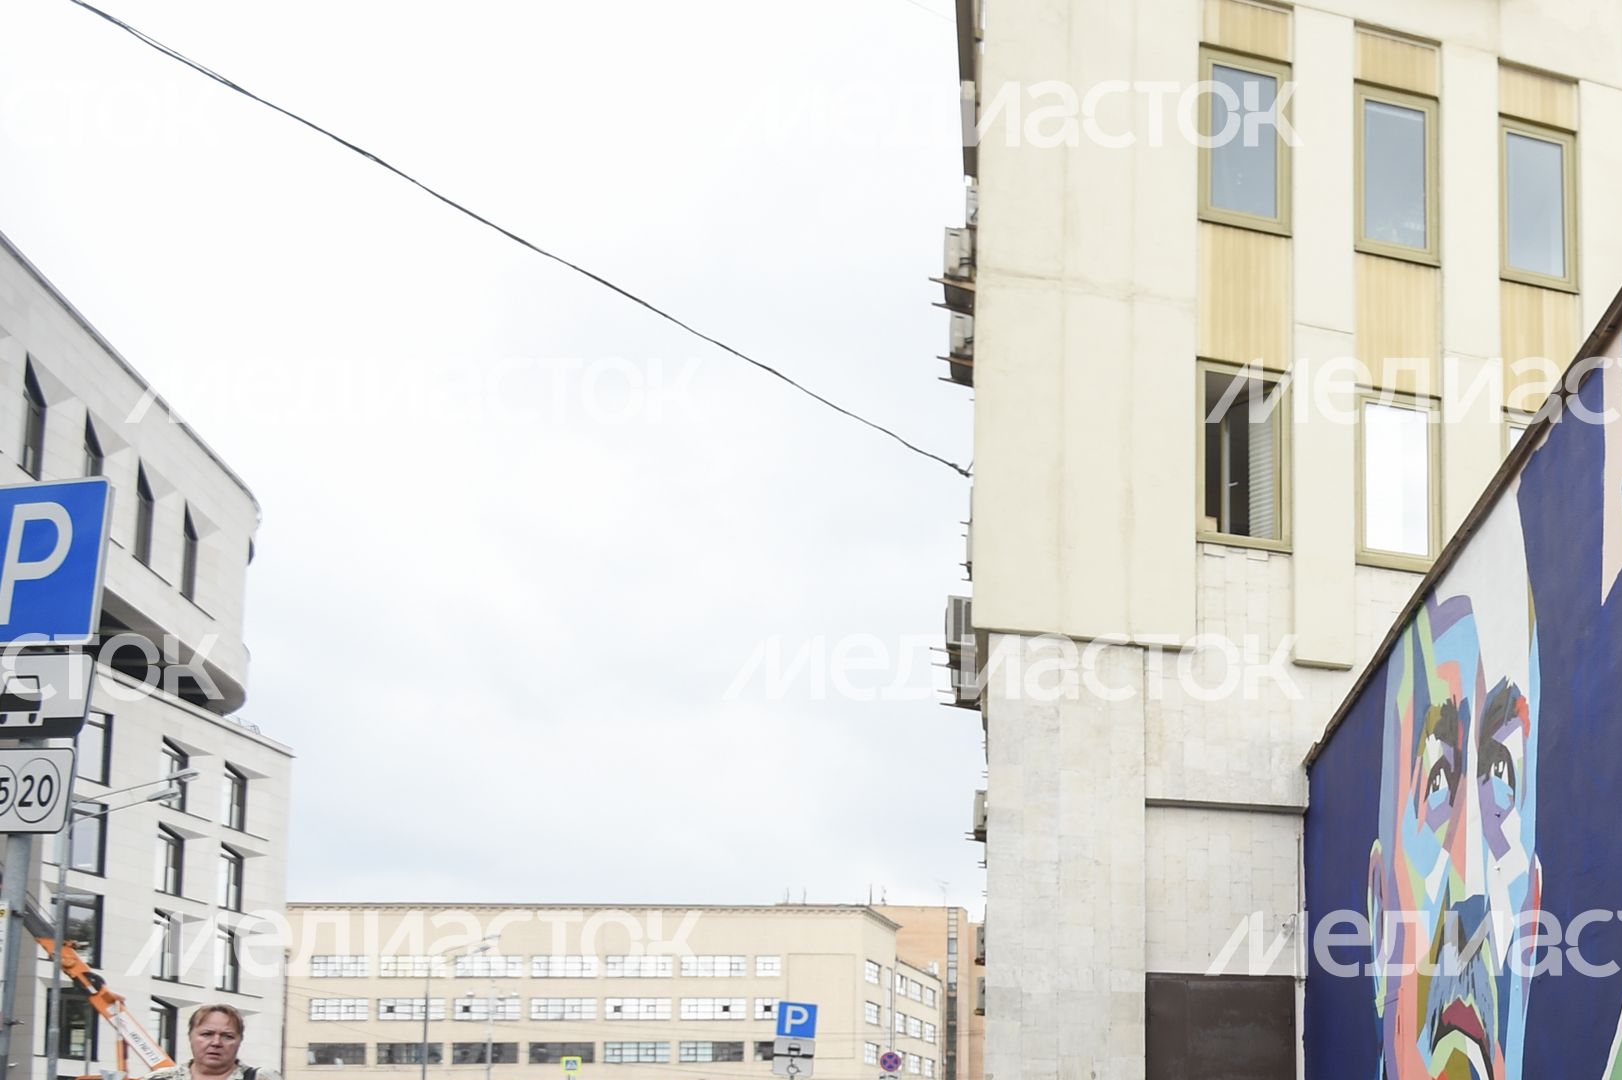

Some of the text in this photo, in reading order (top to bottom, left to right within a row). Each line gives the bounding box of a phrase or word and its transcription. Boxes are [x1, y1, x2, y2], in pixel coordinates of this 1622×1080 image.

[0, 501, 73, 625] P
[18, 774, 53, 807] 20
[785, 1006, 809, 1033] P
